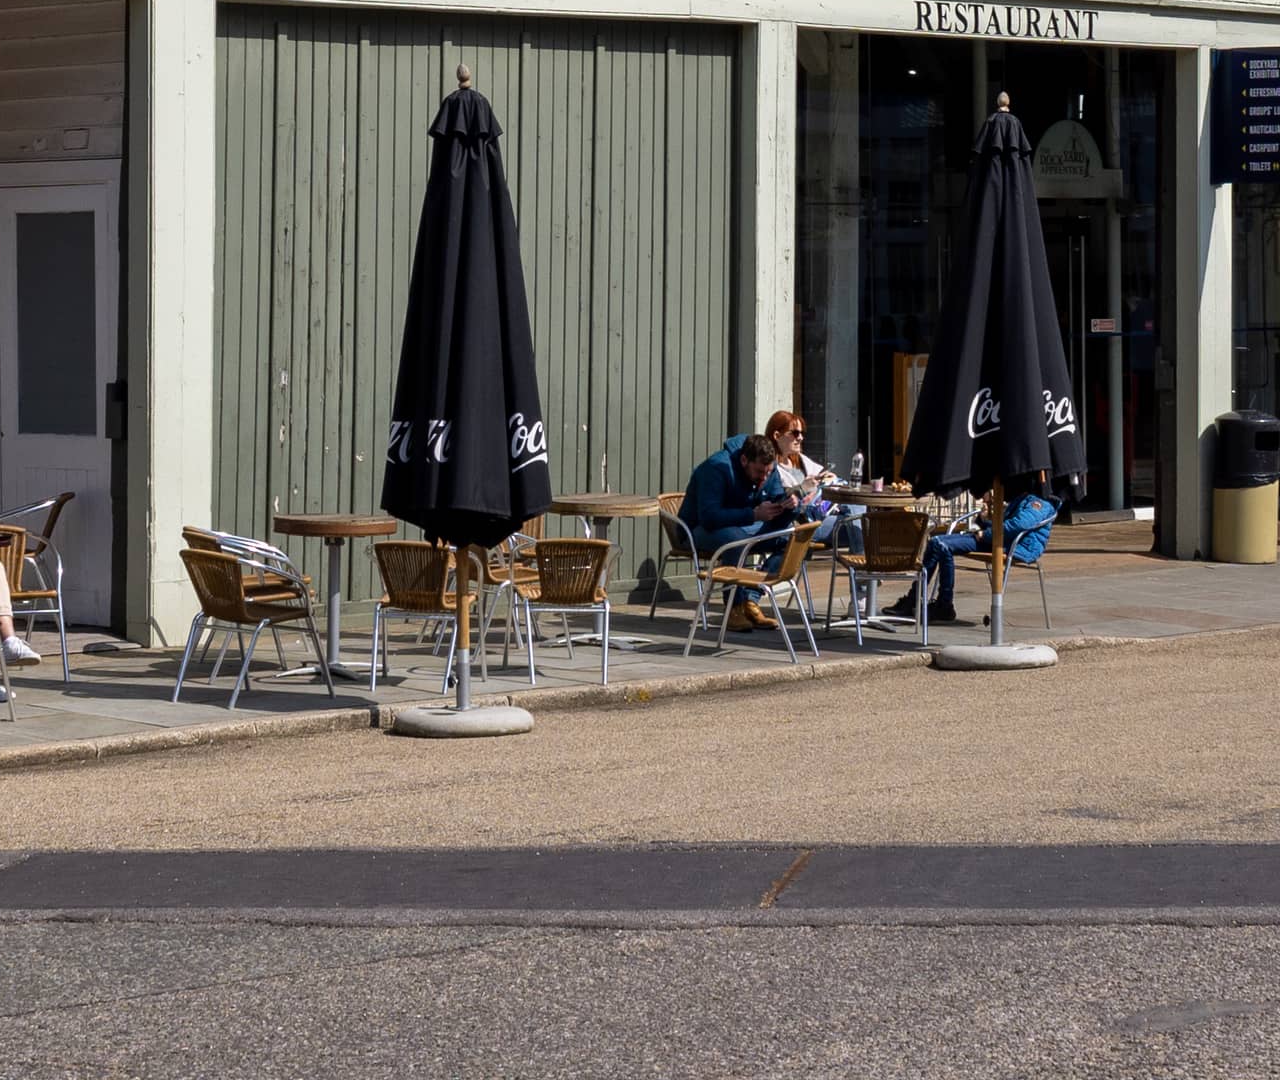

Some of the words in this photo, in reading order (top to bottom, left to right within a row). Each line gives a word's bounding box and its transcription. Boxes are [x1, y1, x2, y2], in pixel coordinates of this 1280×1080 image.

[915, 0, 1098, 41] RESTAURANT
[1249, 59, 1278, 69] DOCKYARD
[1249, 69, 1280, 79] EXHIBITION
[1249, 124, 1280, 134] NAUTICALIA
[1249, 143, 1279, 153] CASHPOINT
[1249, 161, 1271, 171] TOILETS
